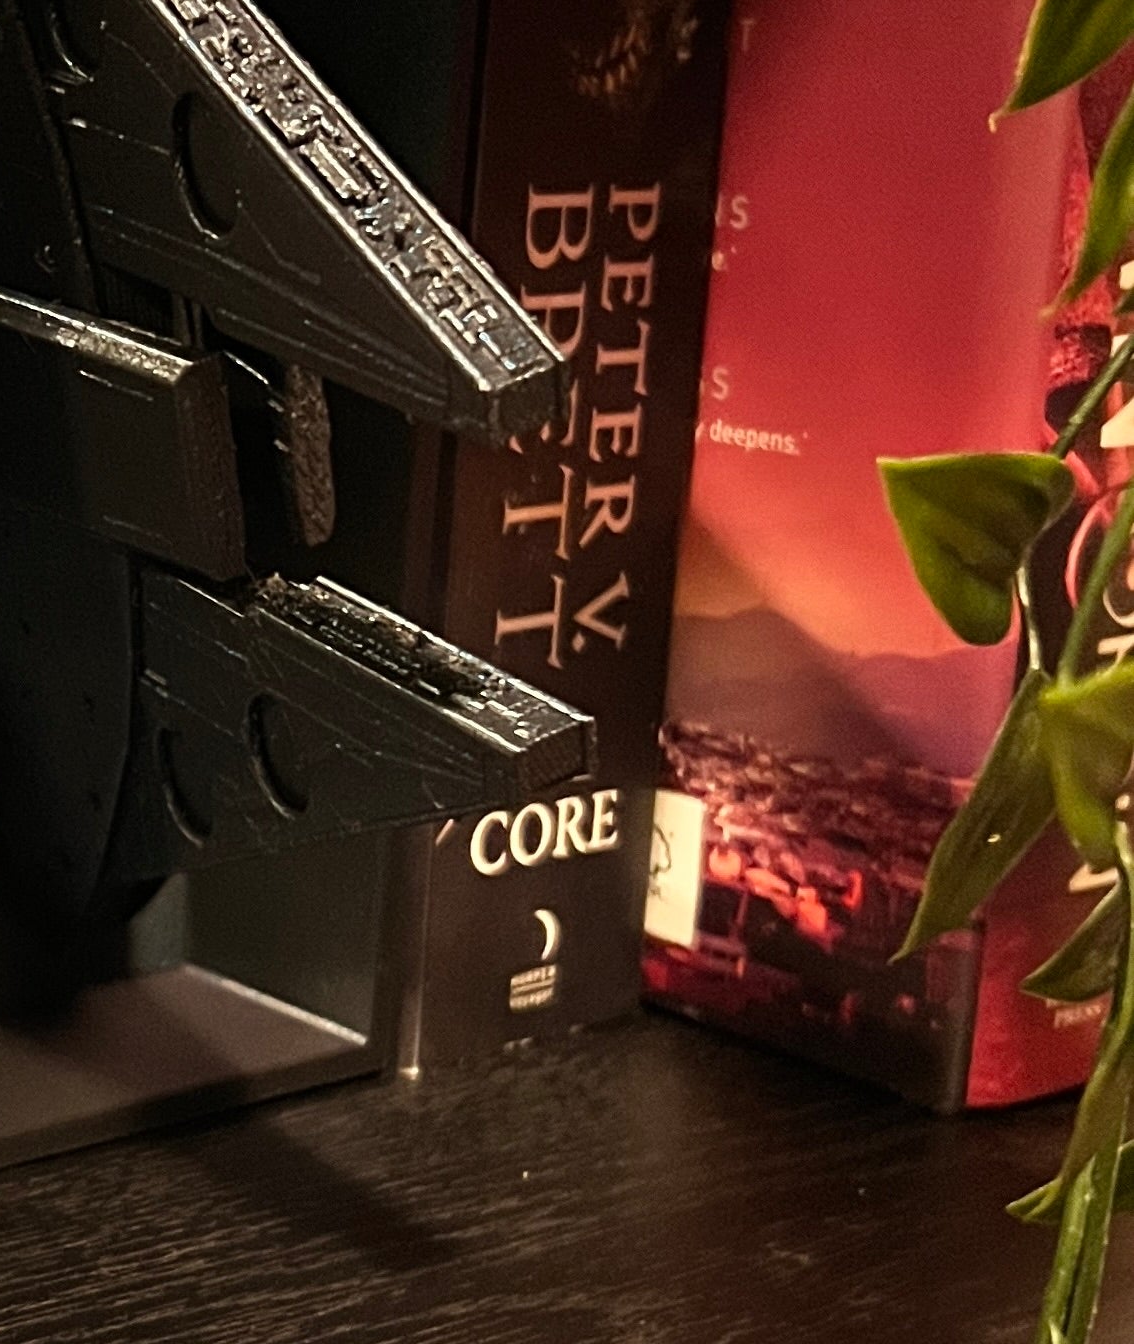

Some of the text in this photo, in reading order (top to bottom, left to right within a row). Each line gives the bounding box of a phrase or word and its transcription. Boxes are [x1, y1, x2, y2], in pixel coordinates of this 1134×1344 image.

[571, 182, 662, 654] PETER V.
[469, 788, 620, 877] CORE
